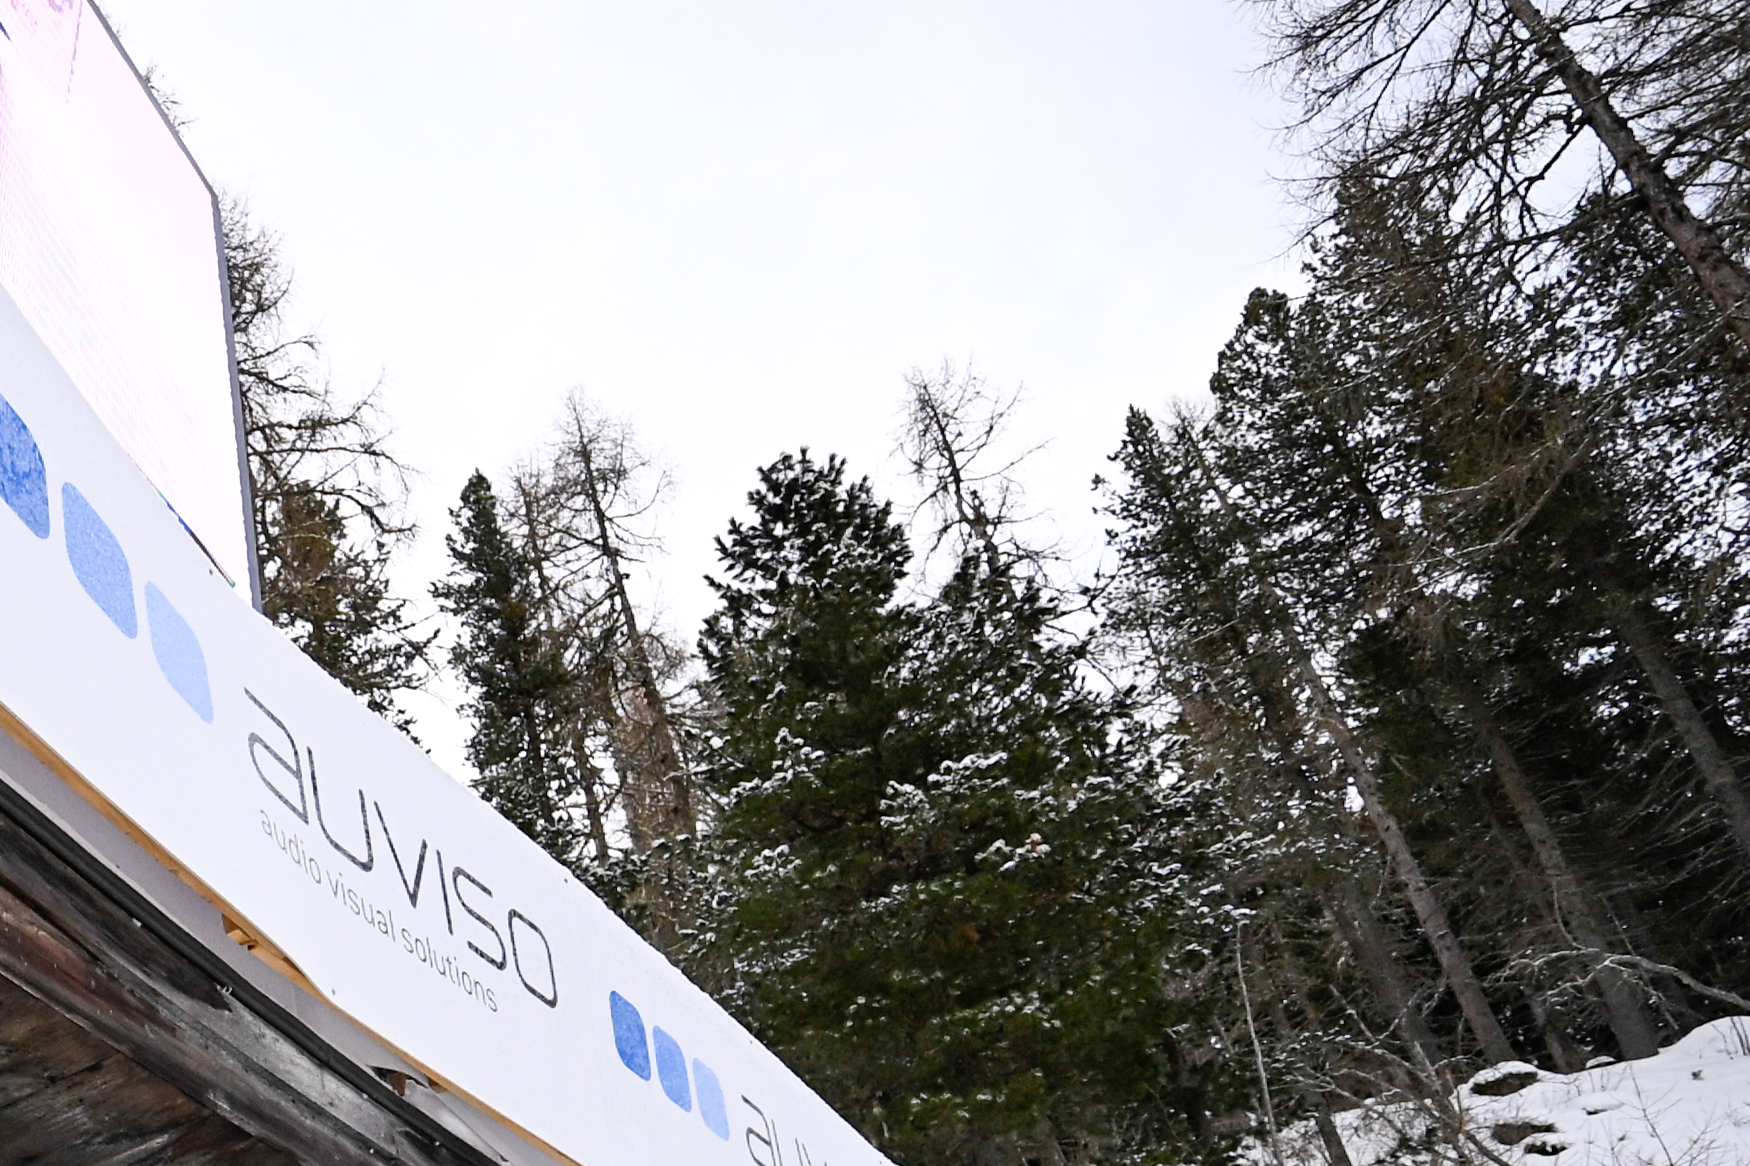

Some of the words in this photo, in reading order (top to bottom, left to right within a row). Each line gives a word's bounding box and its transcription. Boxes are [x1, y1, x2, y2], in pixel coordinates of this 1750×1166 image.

[245, 686, 558, 1008] auviso
[260, 808, 322, 885] audio
[326, 872, 396, 943] visual
[401, 927, 498, 1013] solutions
